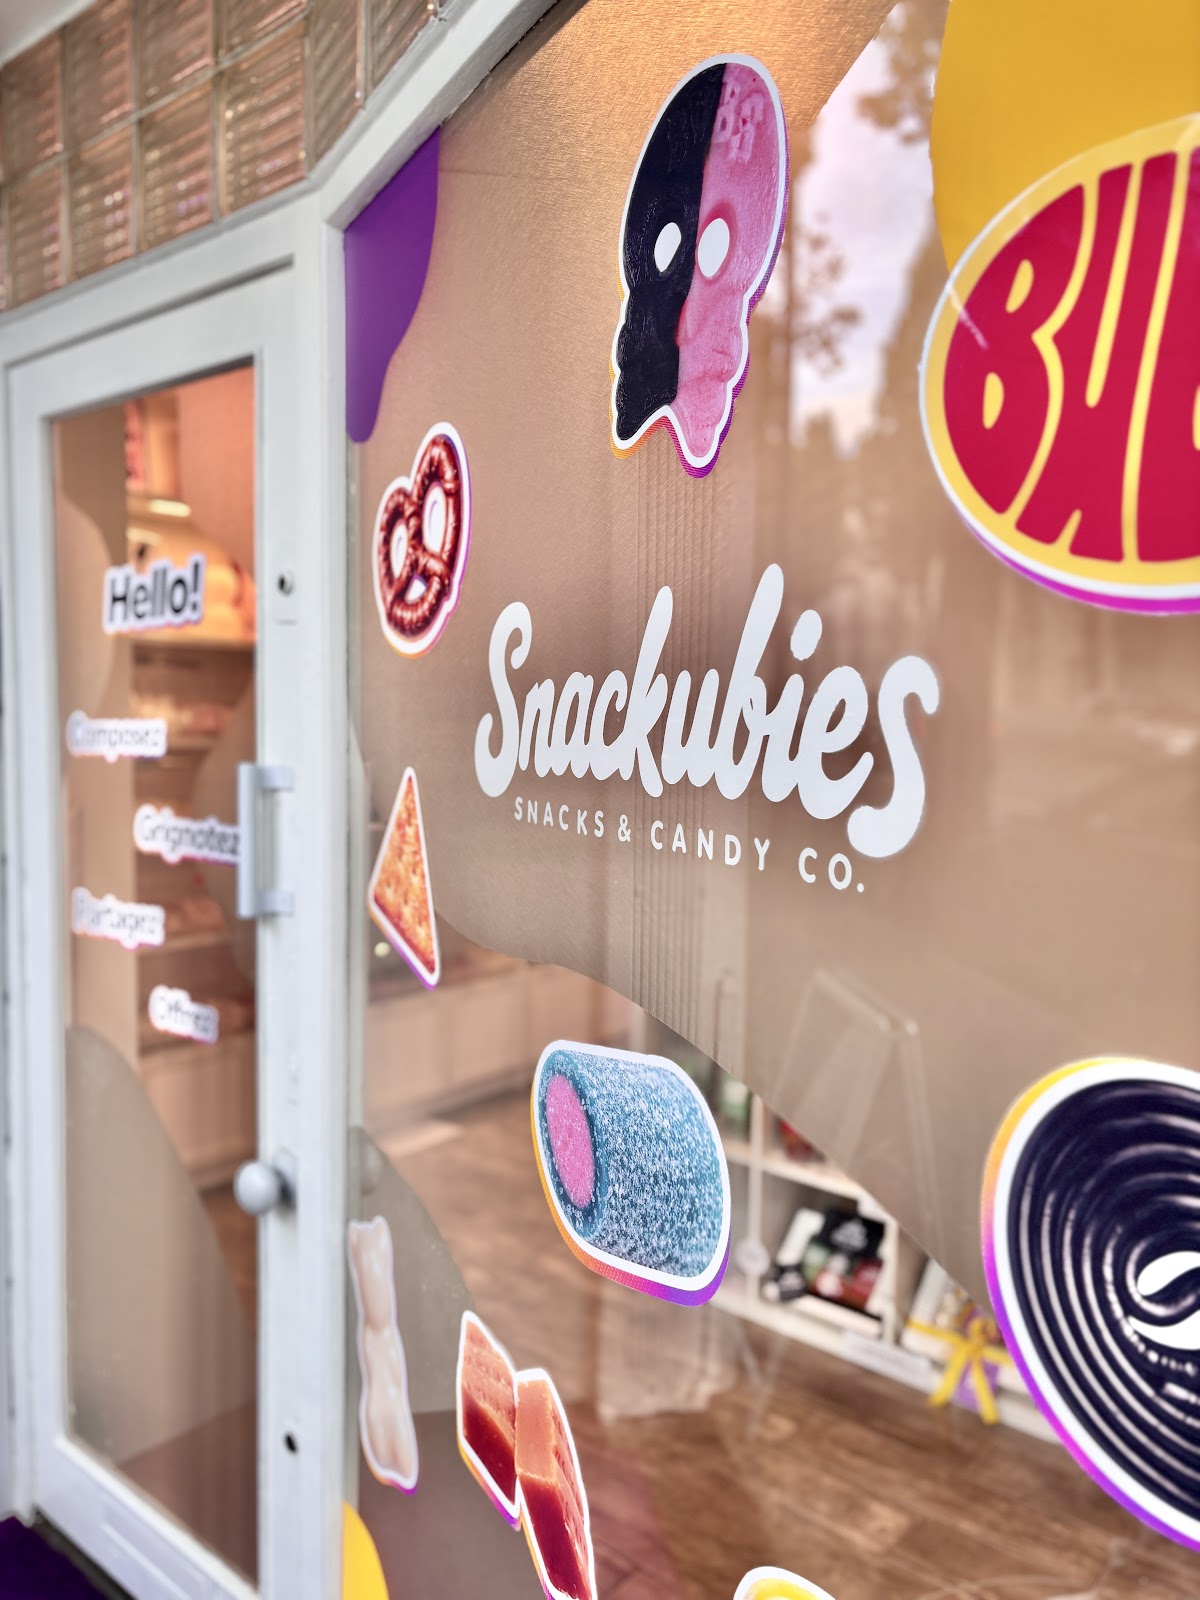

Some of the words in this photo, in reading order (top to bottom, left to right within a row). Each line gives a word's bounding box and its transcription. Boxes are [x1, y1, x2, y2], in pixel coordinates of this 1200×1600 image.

[107, 560, 203, 624] Hello!
[474, 563, 940, 858] Snackubies
[514, 796, 605, 838] SNACKS
[617, 814, 631, 842] &
[650, 820, 770, 871] CANDY
[798, 847, 865, 893] CO.
